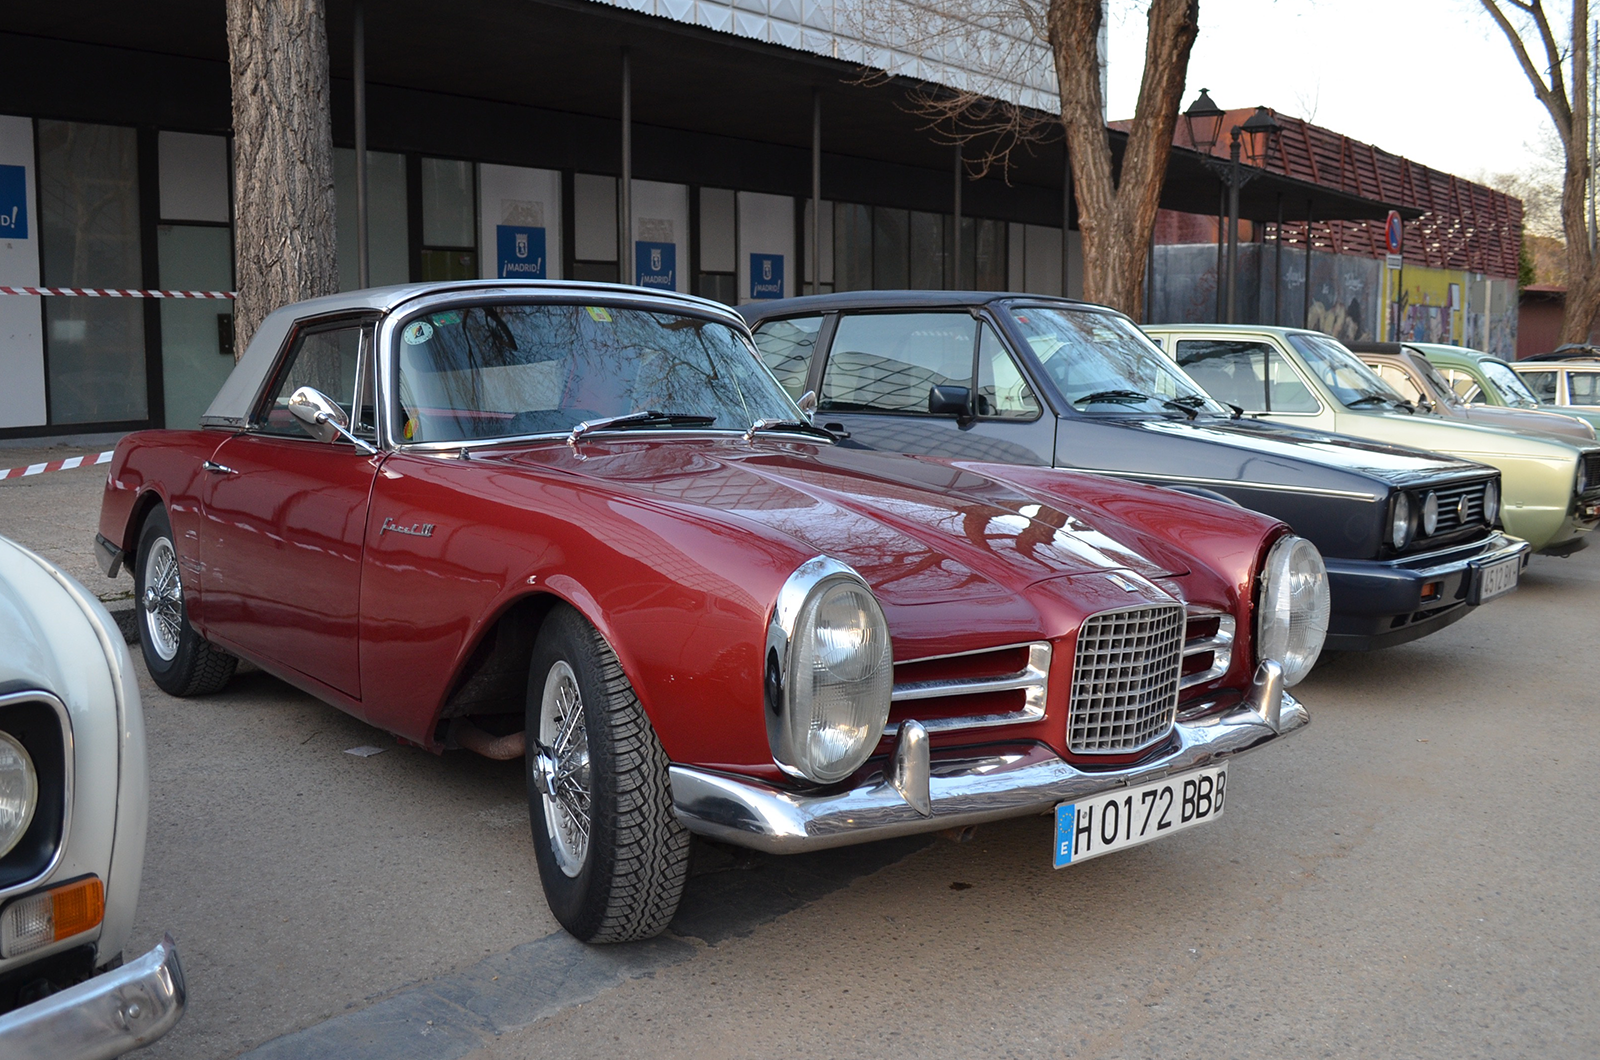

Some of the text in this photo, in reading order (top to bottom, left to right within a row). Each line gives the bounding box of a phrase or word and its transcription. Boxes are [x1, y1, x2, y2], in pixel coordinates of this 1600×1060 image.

[503, 257, 541, 277] ¡MADRID!
[1101, 786, 1174, 845] 0172
[1181, 770, 1226, 823] BBB
[1060, 841, 1069, 855] E
